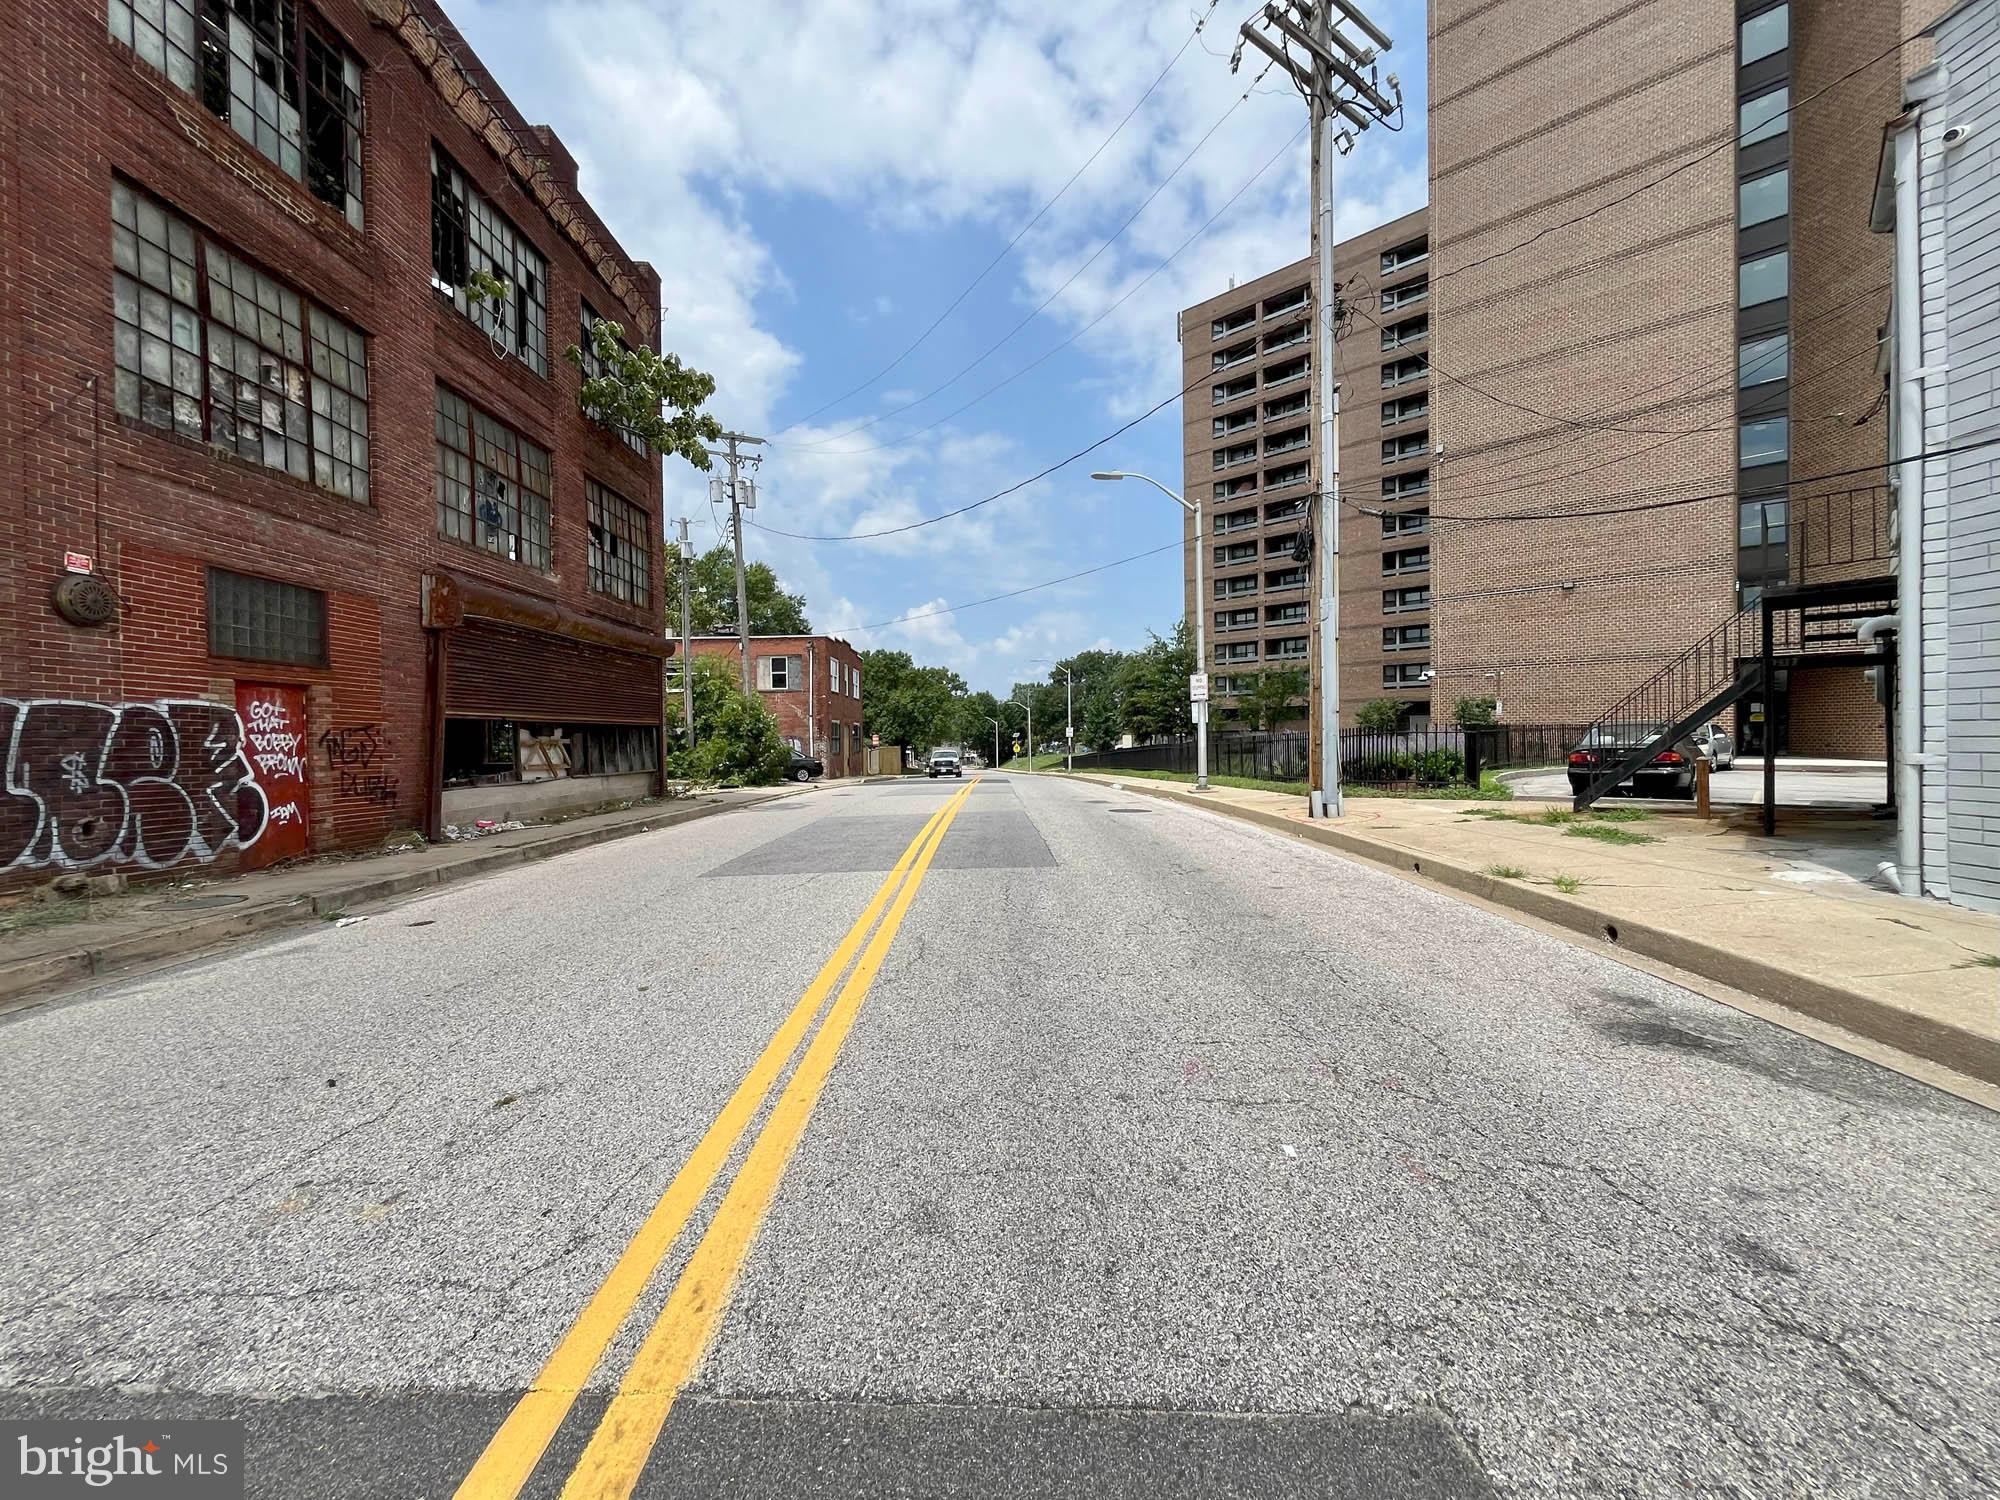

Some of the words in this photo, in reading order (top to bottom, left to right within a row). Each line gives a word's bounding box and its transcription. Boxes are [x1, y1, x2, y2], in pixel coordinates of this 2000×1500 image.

[247, 716, 290, 733] THAT
[249, 732, 302, 756] BOBBY
[253, 753, 307, 783] BROWN
